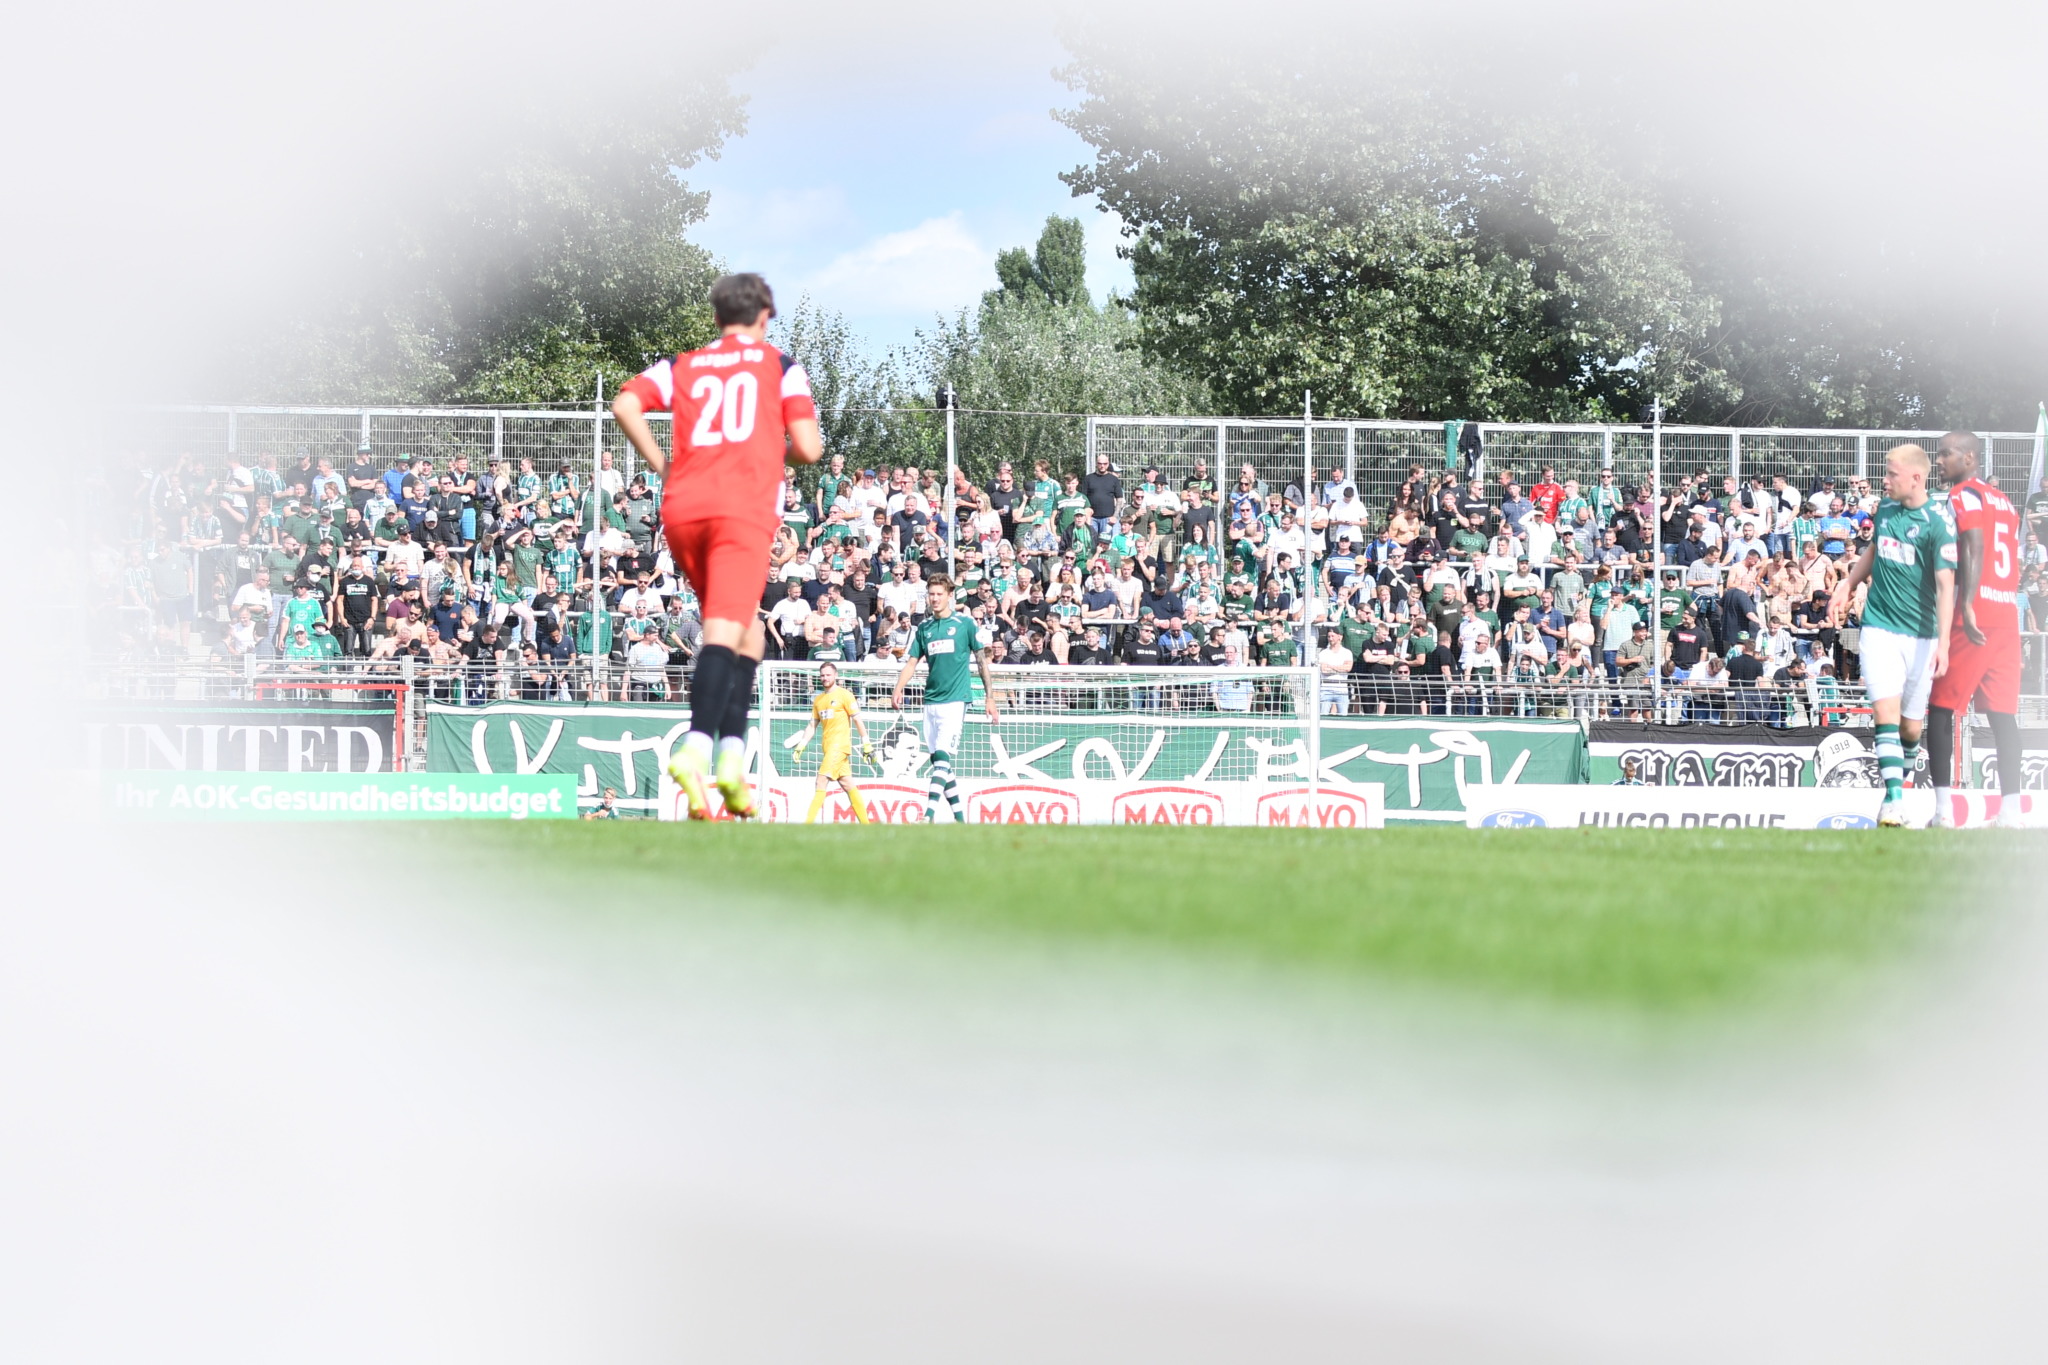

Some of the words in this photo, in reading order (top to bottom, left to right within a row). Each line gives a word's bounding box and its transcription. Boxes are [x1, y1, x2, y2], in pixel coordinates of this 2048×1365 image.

[691, 371, 757, 446] 20
[1994, 522, 2011, 578] 5
[82, 722, 383, 772] UNITED
[1829, 739, 1851, 755] 1919
[116, 783, 159, 808] Ihr
[169, 784, 563, 820] AOK-Gesundheitsbudget
[980, 801, 1069, 824] MAYO
[1125, 803, 1213, 825] MAYO
[1269, 804, 1356, 827] MAYO
